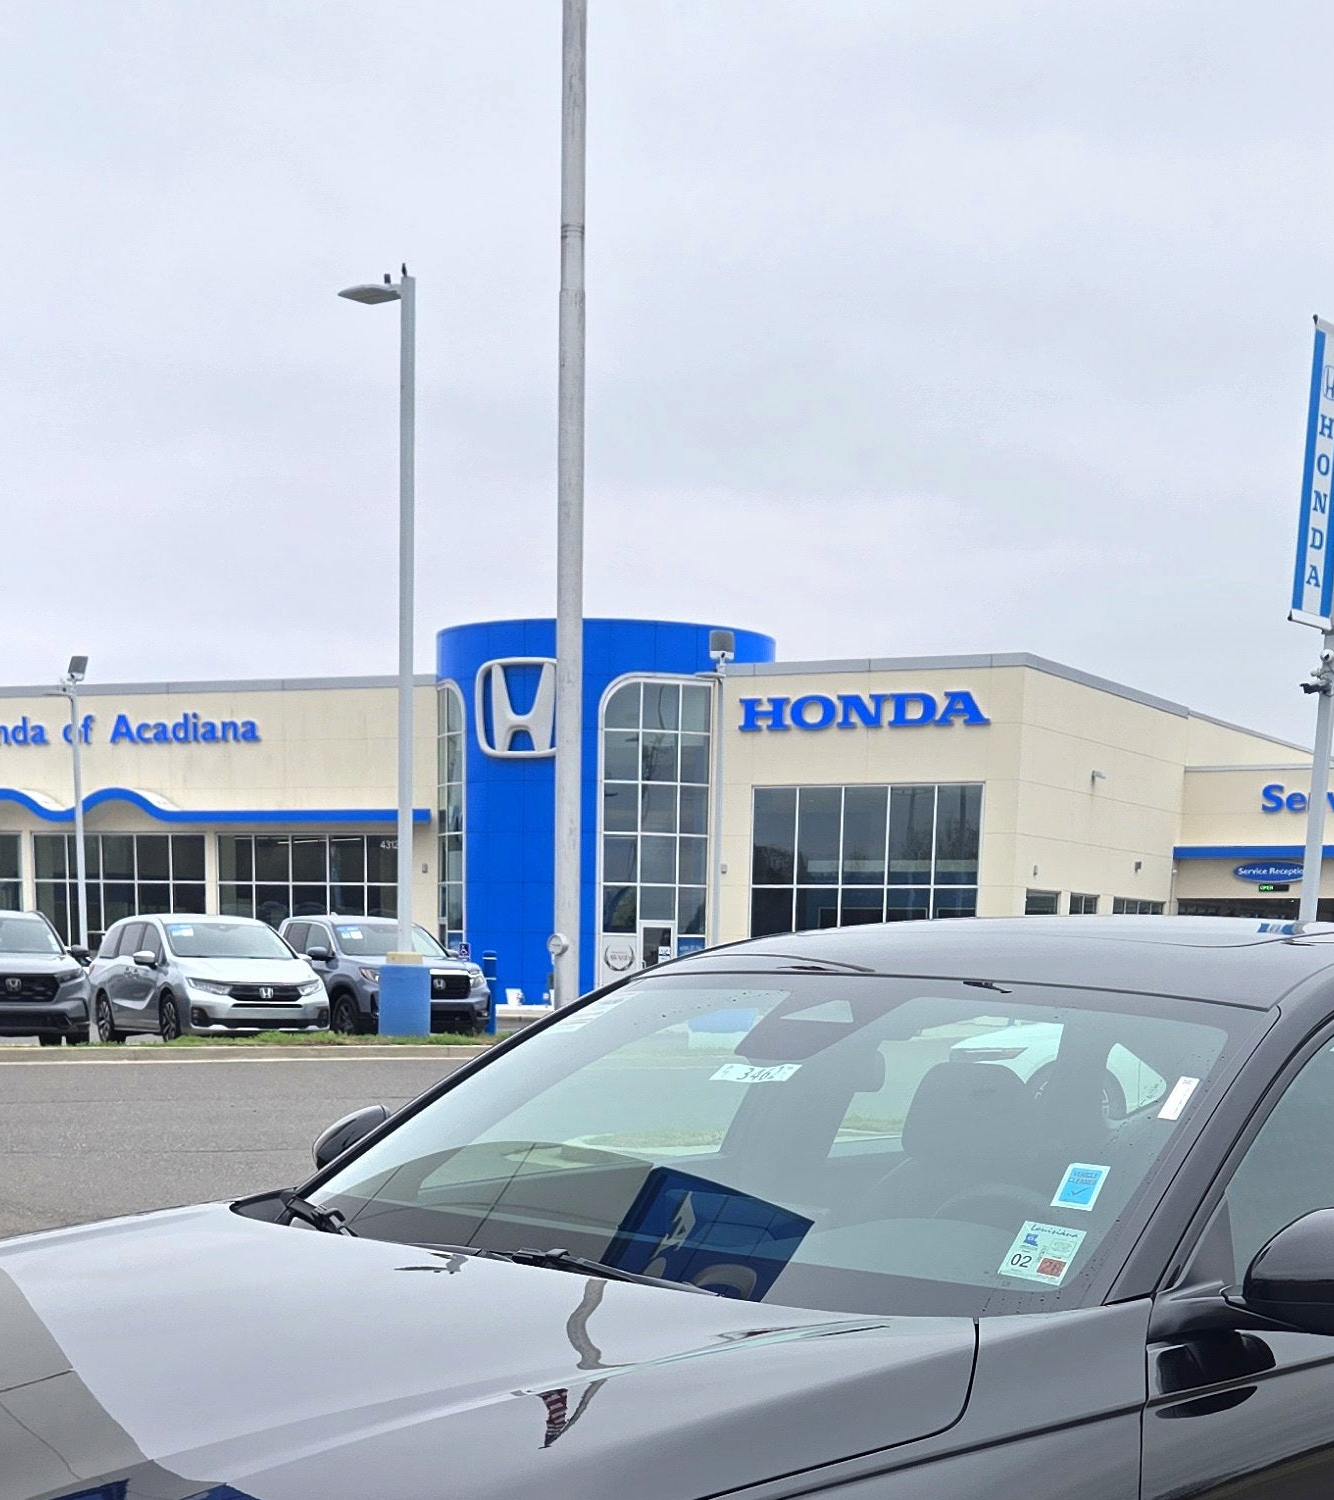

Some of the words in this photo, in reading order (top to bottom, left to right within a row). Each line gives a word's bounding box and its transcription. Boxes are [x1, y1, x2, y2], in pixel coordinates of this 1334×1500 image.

[1305, 413, 1334, 588] HONDA
[738, 689, 991, 732] HONDA
[109, 711, 262, 745] Acadiana
[1238, 867, 1267, 875] Service
[1030, 1223, 1079, 1239] Louisiana
[1010, 1253, 1033, 1269] 02
